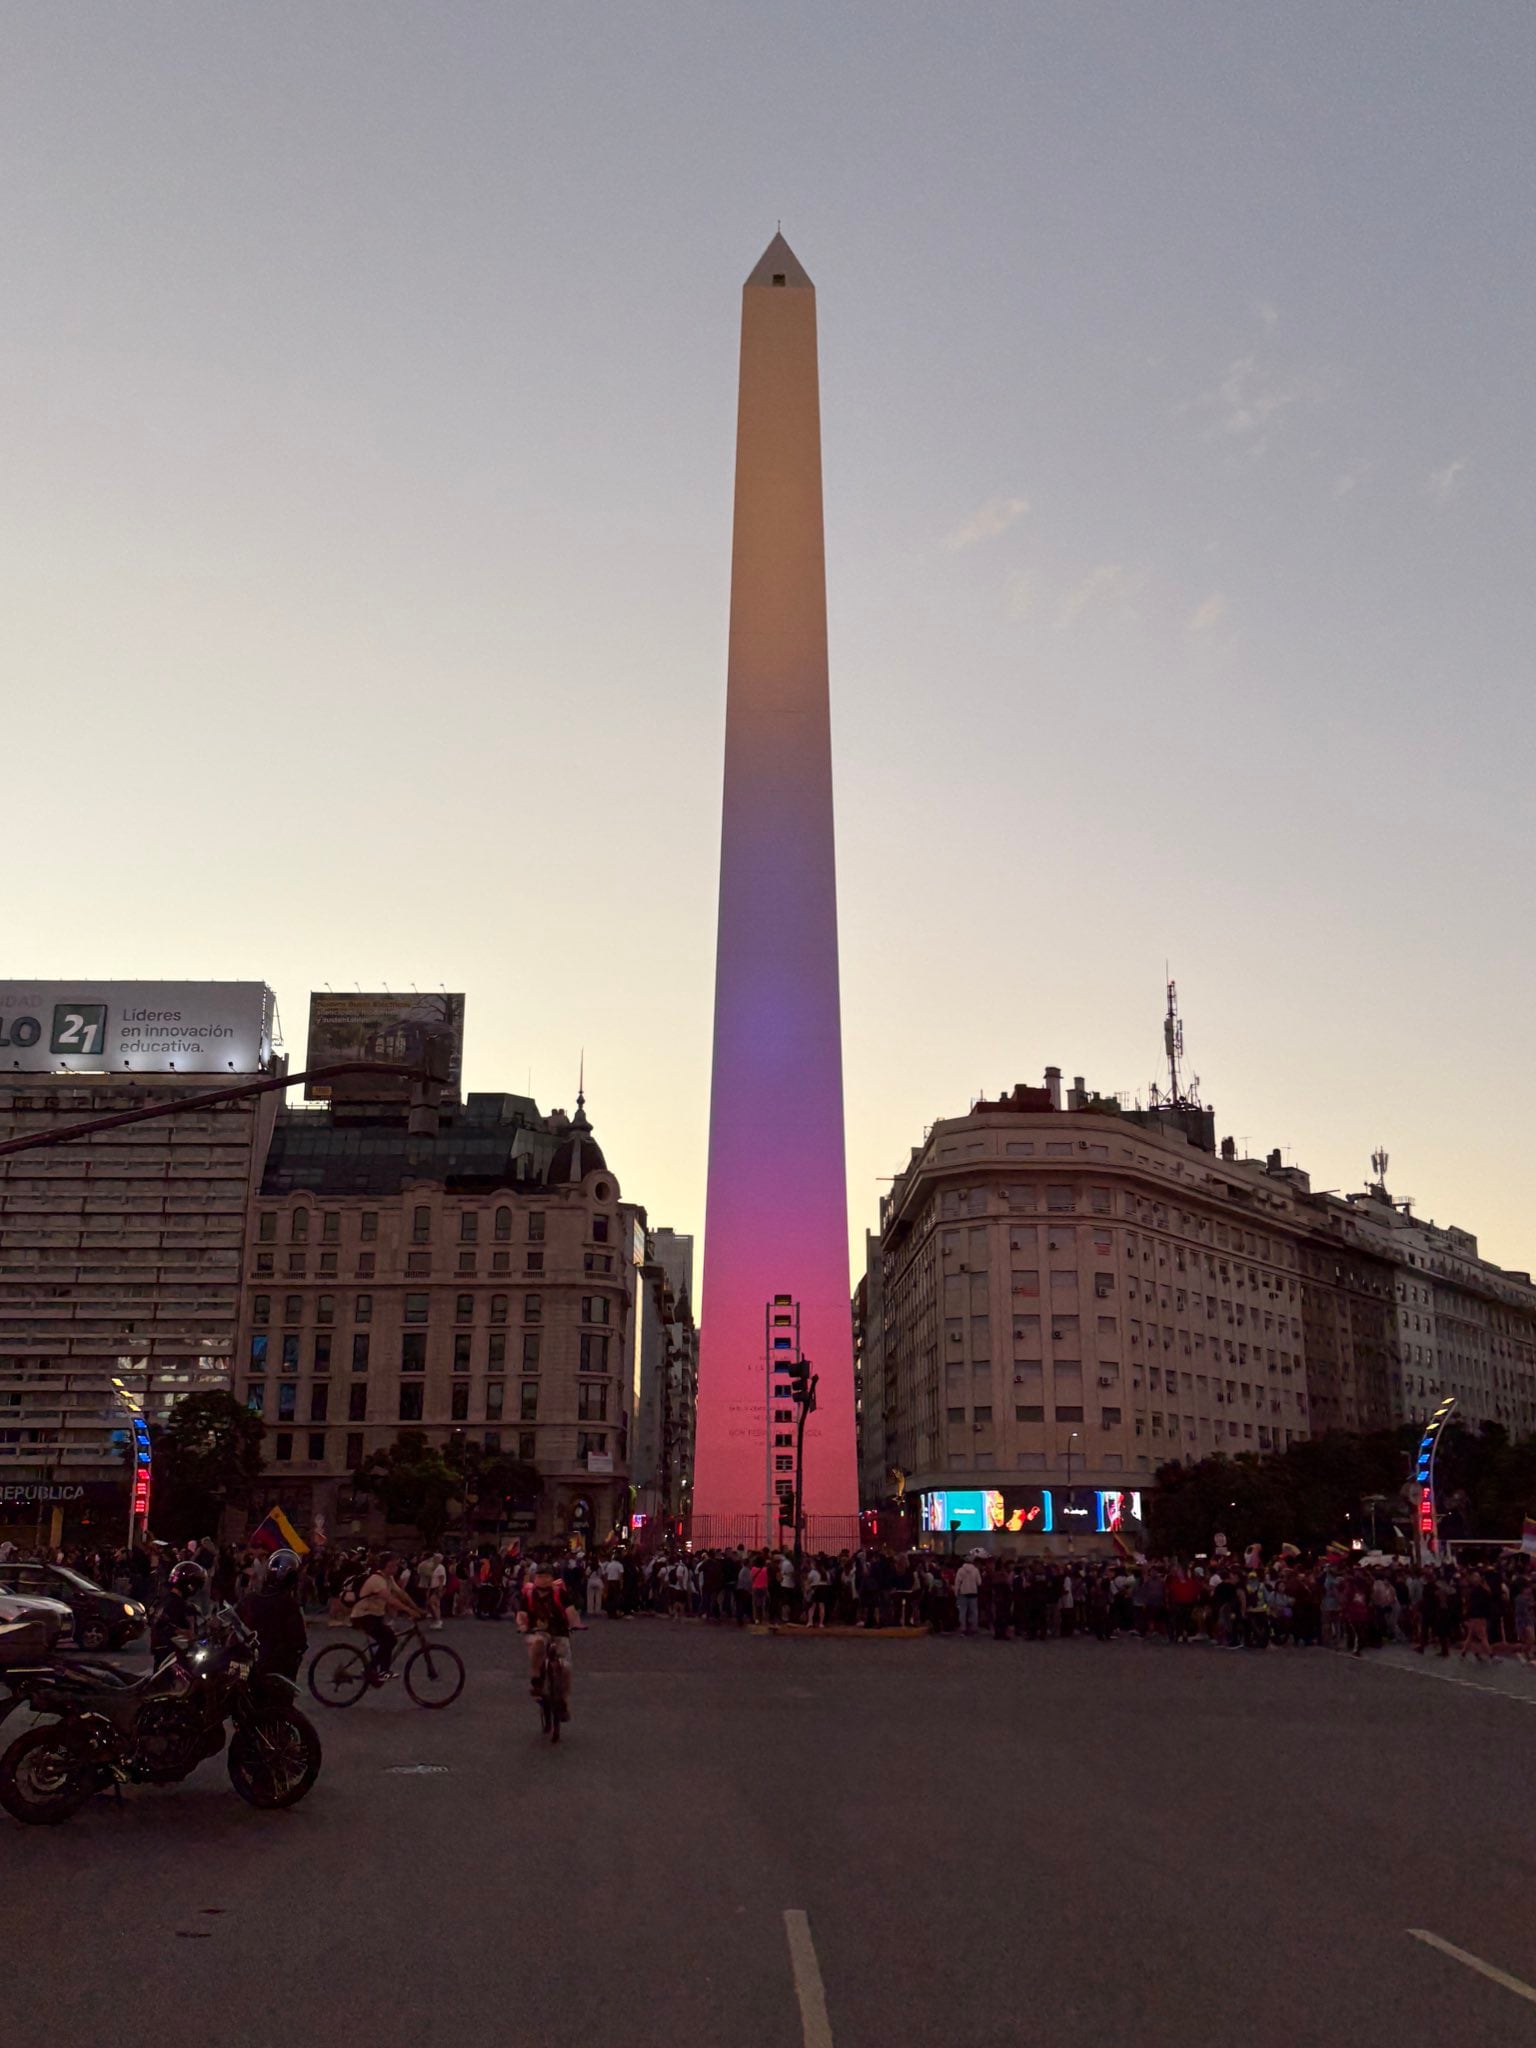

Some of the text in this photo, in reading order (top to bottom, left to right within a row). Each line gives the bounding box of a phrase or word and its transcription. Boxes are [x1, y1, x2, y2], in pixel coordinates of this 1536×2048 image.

[122, 1008, 182, 1022] Líderes
[58, 1014, 97, 1053] 21
[121, 1024, 234, 1038] en innovación
[120, 1039, 204, 1053] educativa.
